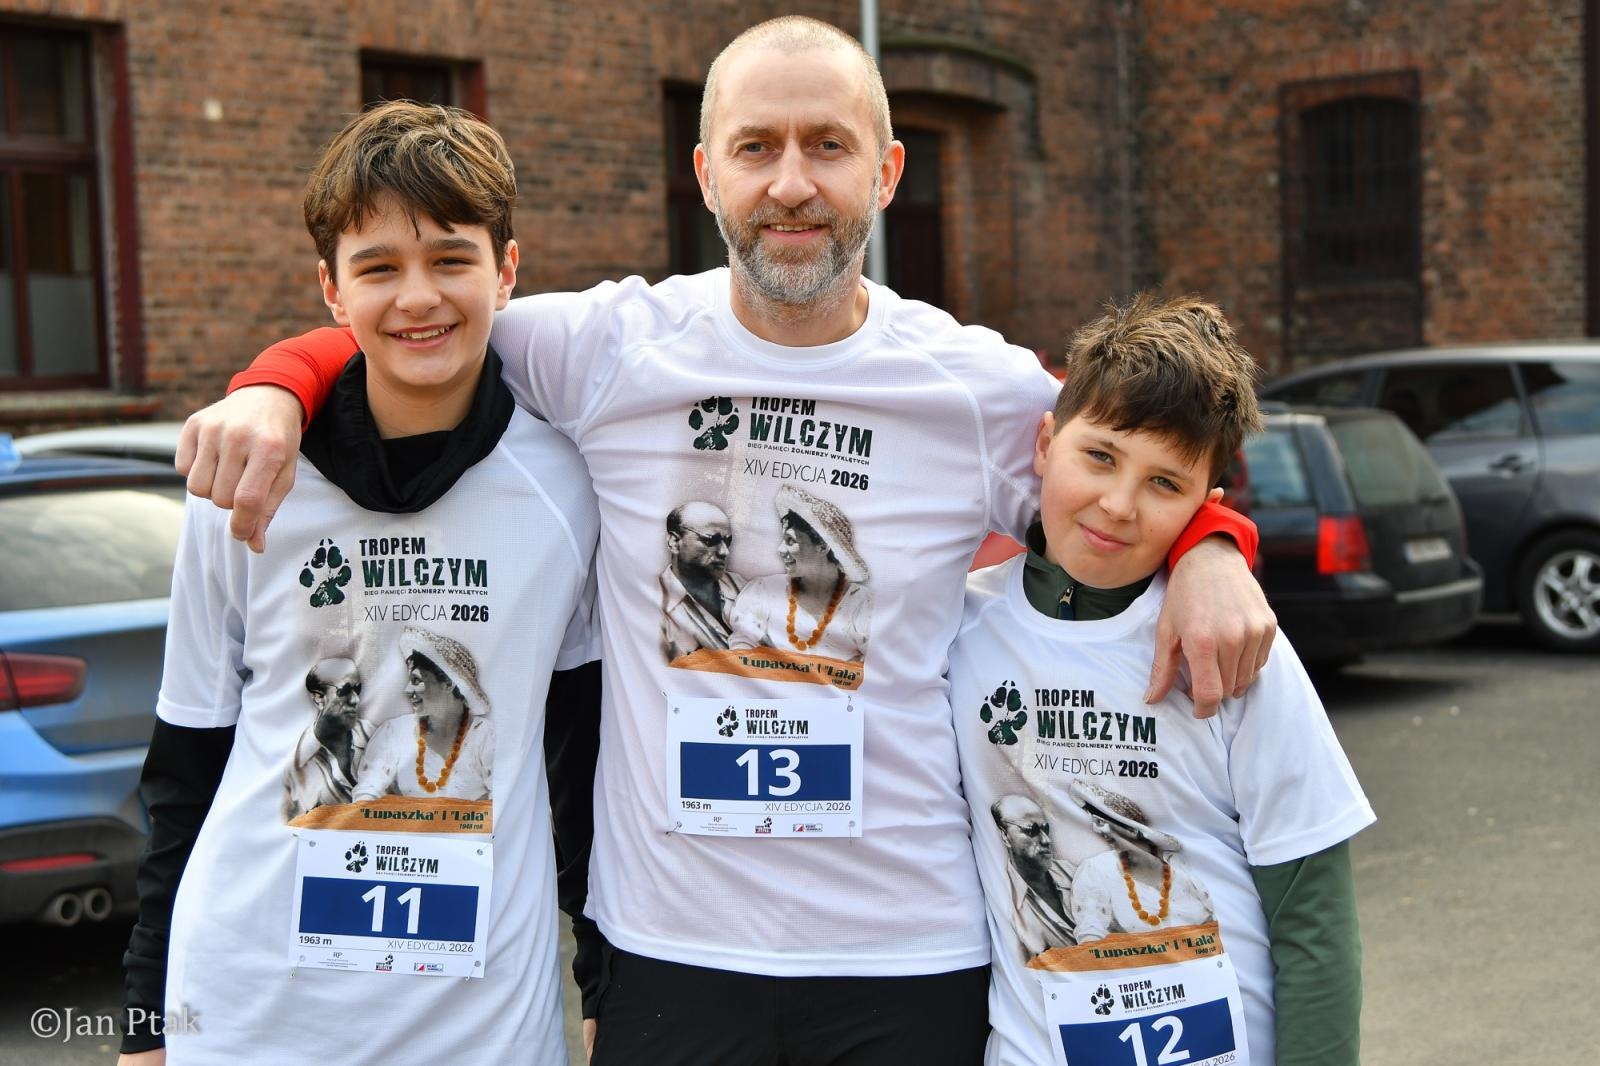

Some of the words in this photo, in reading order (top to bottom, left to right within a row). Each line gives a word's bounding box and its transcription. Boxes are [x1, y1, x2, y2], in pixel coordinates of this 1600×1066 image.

[751, 397, 816, 416] TROPEM
[750, 413, 873, 457] WILCZYM
[830, 453, 870, 466] WYKLĘTYCH
[744, 458, 769, 476] XIV
[772, 461, 827, 484] EDYCJA
[830, 469, 869, 490] 2026
[359, 537, 425, 556] TROPEM
[362, 558, 488, 587] WILCZYM
[364, 605, 388, 622] XIV
[392, 604, 447, 621] EDYCJA
[451, 604, 489, 622] 2026
[1035, 689, 1094, 708] TROPEM
[745, 709, 778, 718] TROPEM
[746, 720, 809, 735] WILCZYM
[1036, 710, 1157, 744] WILCZYM
[1115, 743, 1156, 752] WYKLĘTYCH
[735, 748, 802, 797] 13
[1034, 753, 1058, 770] XIV
[1062, 757, 1115, 776] EDYCJA
[1118, 760, 1159, 779] 2026
[682, 801, 701, 810] 1963
[764, 802, 782, 811] XIV
[785, 802, 824, 811] EDYCJA
[826, 802, 851, 811] 2026
[376, 845, 409, 855] TROPEM
[376, 856, 438, 874] WILCZYM
[361, 885, 422, 935] 11
[299, 936, 320, 945] 1963
[387, 940, 404, 950] XIV
[407, 941, 446, 951] EDYCJA
[448, 943, 474, 952] 2026
[1118, 980, 1152, 994] TROPEM
[1121, 984, 1186, 1010] WILCZYM
[1118, 1015, 1191, 1066] 12
[1213, 1052, 1235, 1066] 2026
